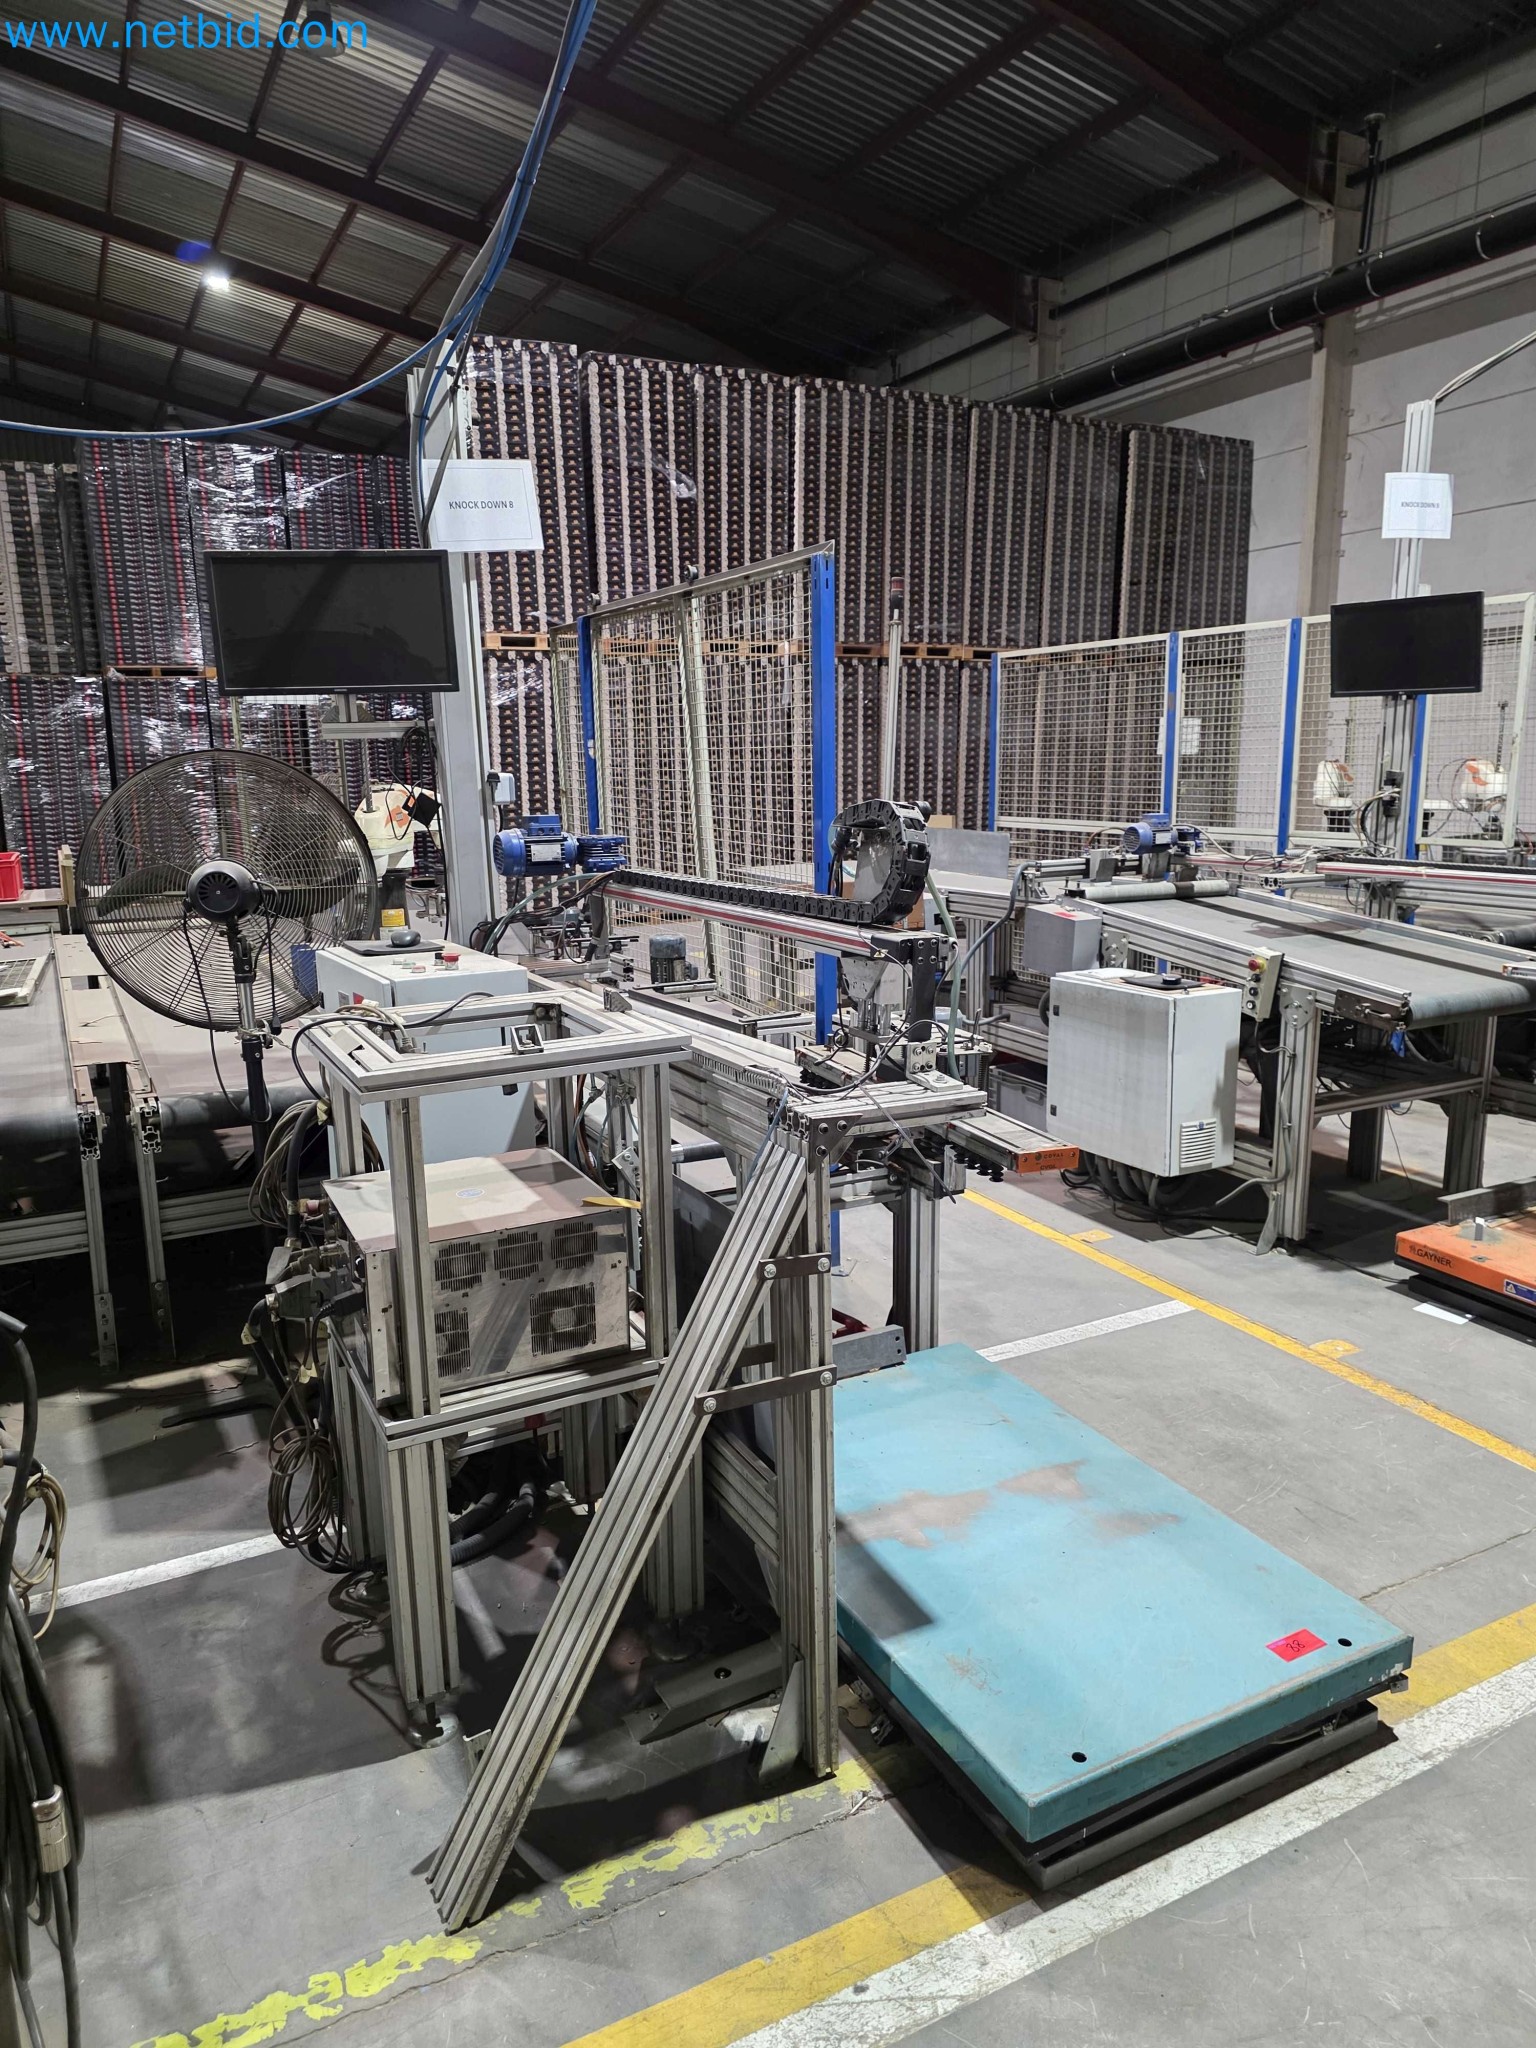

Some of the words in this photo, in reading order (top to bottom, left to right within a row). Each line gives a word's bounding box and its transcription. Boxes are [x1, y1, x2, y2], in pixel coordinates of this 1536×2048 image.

[448, 501, 480, 509] KNOCK
[481, 501, 507, 509] DOWN
[1416, 1249, 1453, 1268] GAYNER
